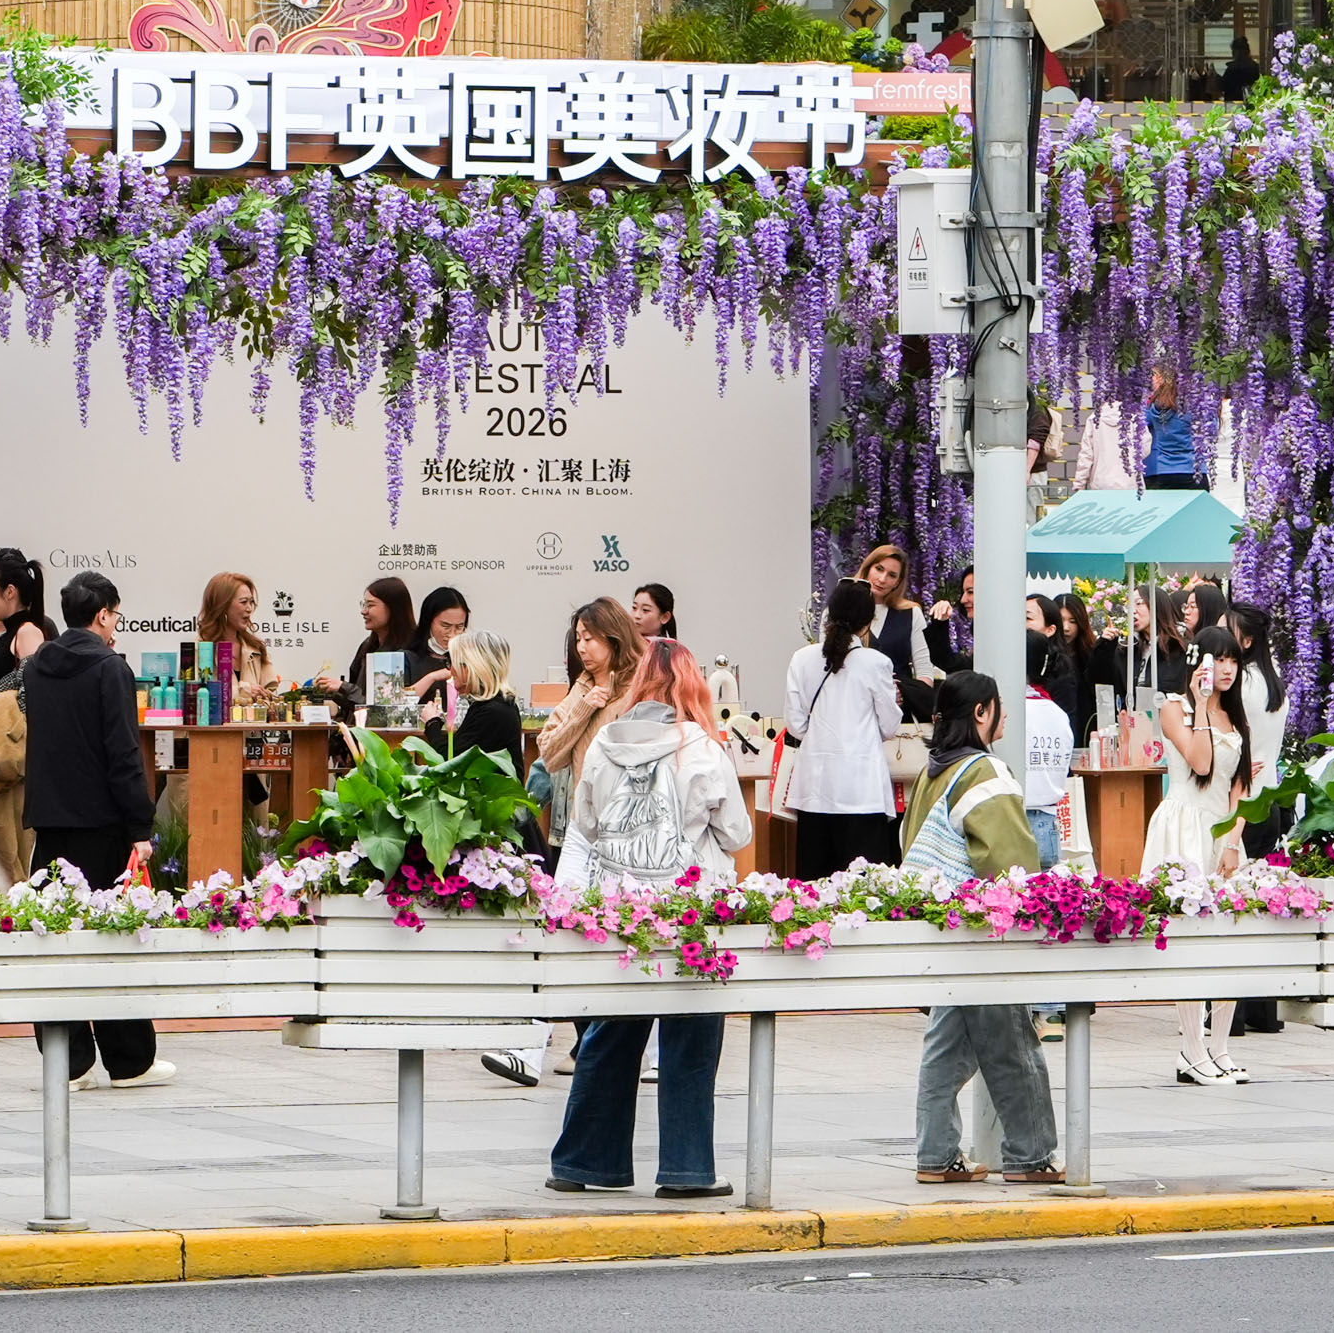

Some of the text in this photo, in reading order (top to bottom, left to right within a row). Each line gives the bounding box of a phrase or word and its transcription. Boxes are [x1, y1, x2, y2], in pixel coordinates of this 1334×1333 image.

[873, 78, 971, 100] femfresh
[485, 406, 568, 437] 2026
[420, 457, 632, 483] 英伦绽放·汇聚上海
[378, 544, 438, 556] 企业赞助商
[378, 560, 505, 571] CORPORATE SPONSOR
[593, 559, 630, 572] YASO
[250, 622, 330, 633] OBLE ISLE
[1033, 736, 1061, 749] 2026
